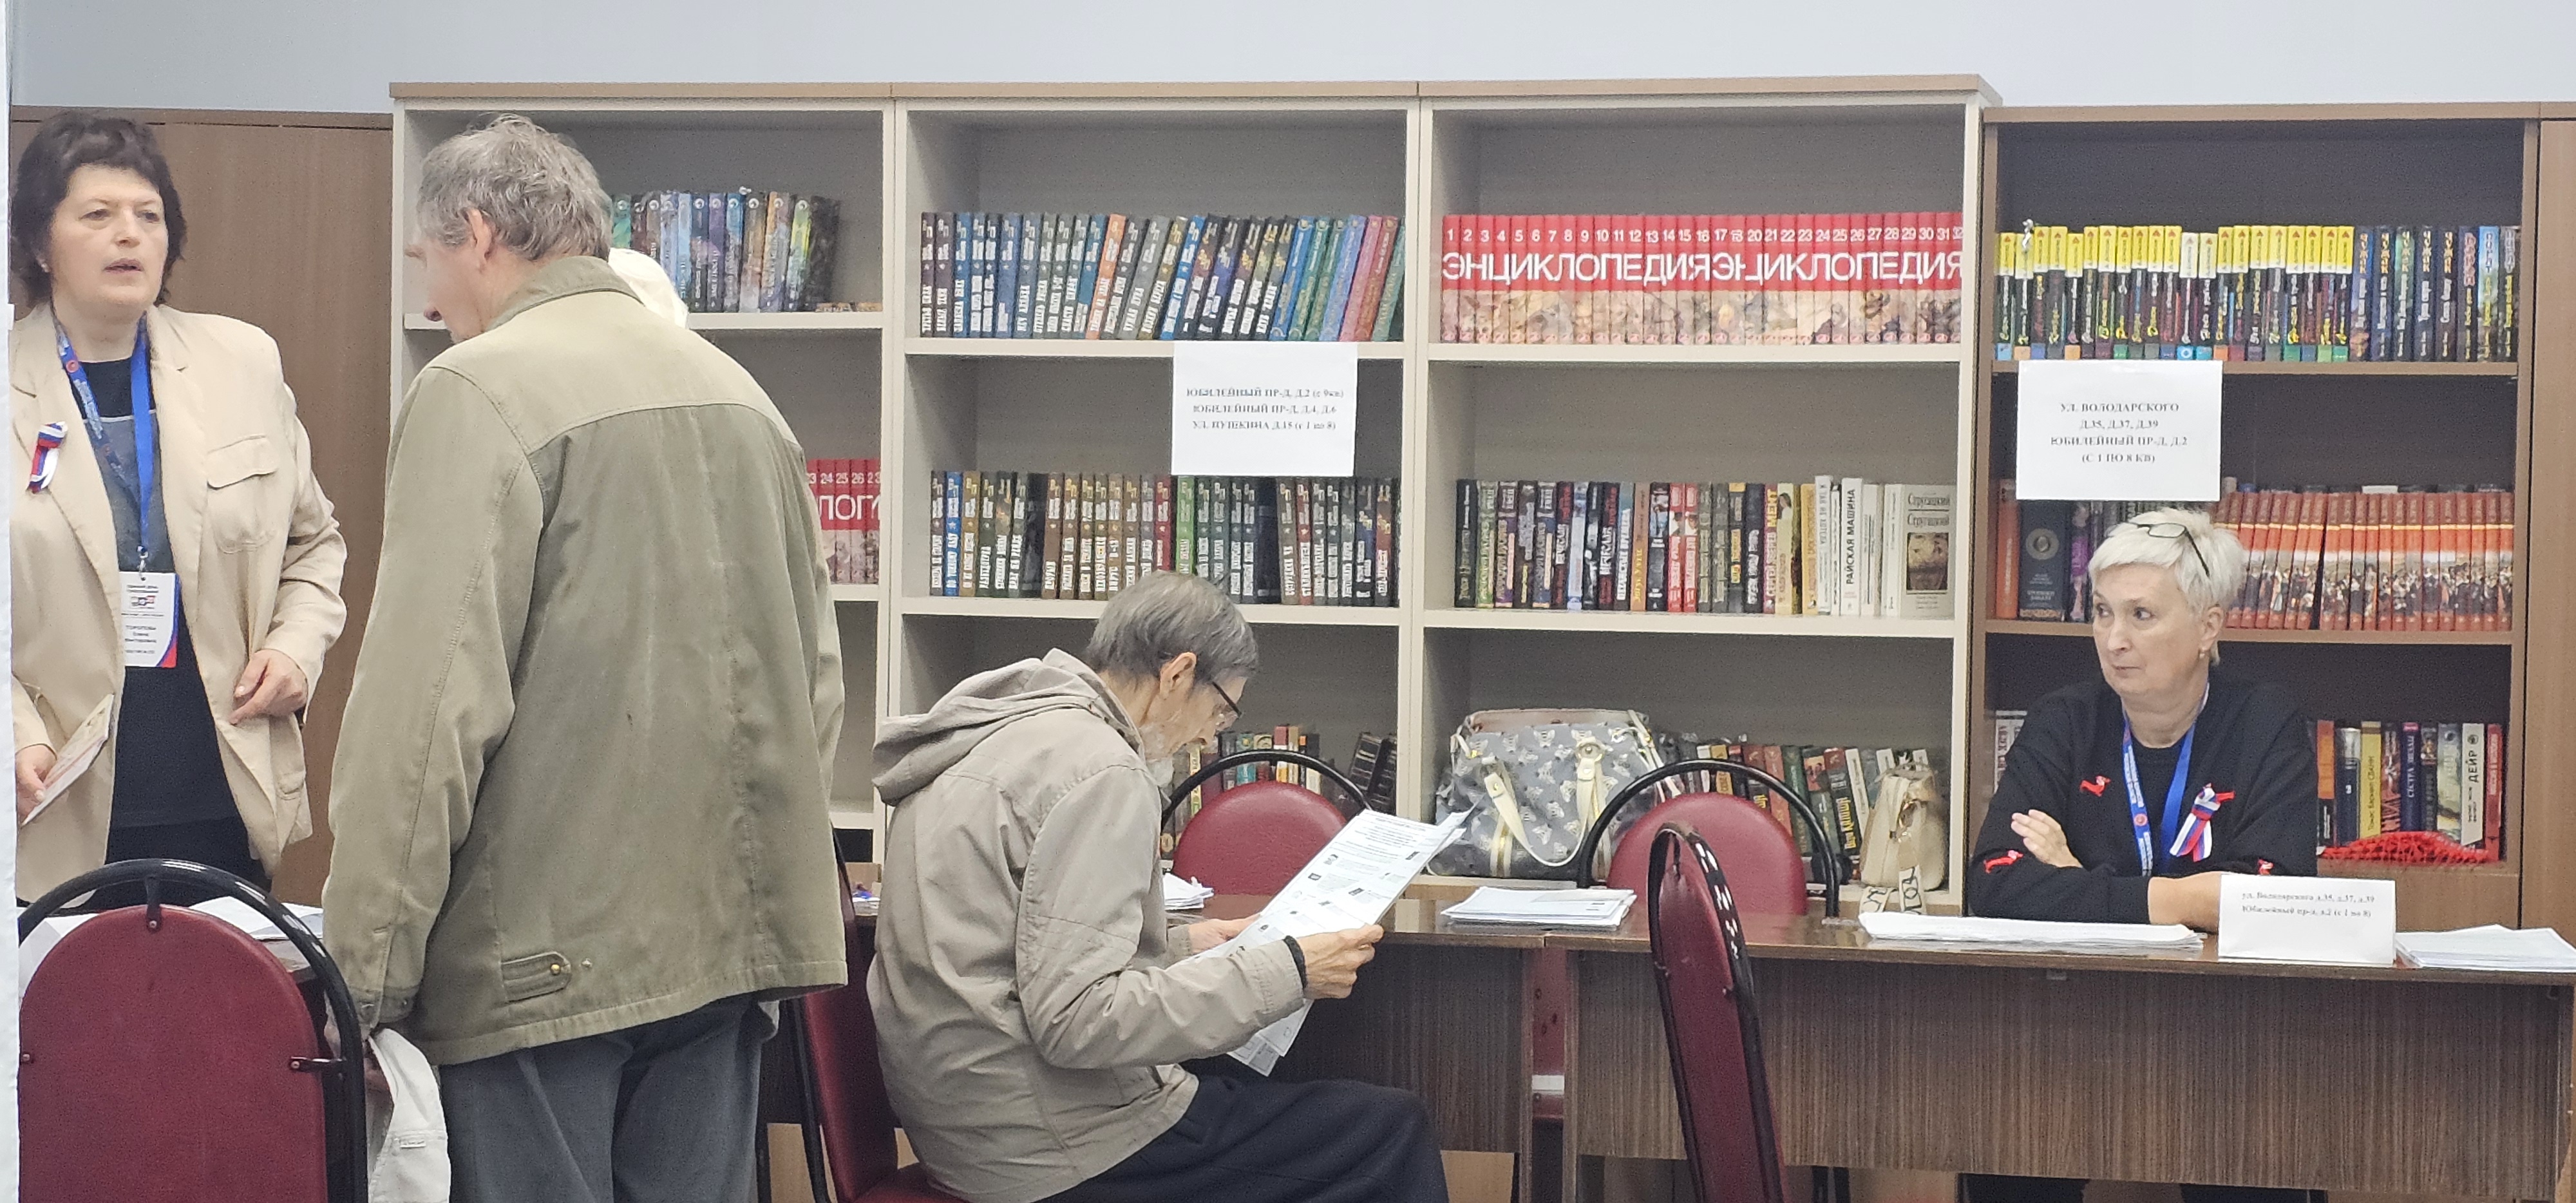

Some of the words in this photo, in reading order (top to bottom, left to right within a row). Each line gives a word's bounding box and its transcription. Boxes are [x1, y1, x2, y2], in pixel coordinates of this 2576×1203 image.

[1447, 229, 1454, 243] 1
[1463, 229, 1473, 243] 2
[1480, 229, 1490, 243] 3
[1496, 229, 1506, 243] 4
[1514, 229, 1524, 243] 5
[1531, 229, 1540, 243] 6
[1548, 229, 1557, 243] 7
[1564, 229, 1574, 243] 8
[1580, 229, 1589, 243] 9
[1596, 229, 1610, 243] 10
[1613, 229, 1624, 243] 11
[1629, 229, 1642, 243] 12
[1645, 229, 1659, 243] 13
[1663, 229, 1675, 243] 14
[1678, 229, 1692, 243] 15
[1696, 227, 1710, 242] 16
[1714, 227, 1728, 242] 17
[1747, 227, 1763, 242] 20
[1765, 227, 1777, 242] 21
[1781, 227, 1795, 242] 22
[1797, 227, 1812, 242] 23
[1815, 227, 1830, 242] 24
[1832, 227, 1848, 242] 25
[1850, 227, 1865, 242] 26
[1868, 227, 1882, 242] 27
[1884, 227, 1899, 242] 28
[1901, 227, 1917, 242] 29
[1918, 227, 1934, 242] 30
[1936, 227, 1950, 242] 31
[1442, 252, 1710, 287] ЭНЦИКЛОПЕДИЯ
[2081, 403, 2179, 413] ВОЛОДАРСКОГО
[2051, 435, 2134, 446] ЮБИЛЕЙНЫЙ
[820, 471, 833, 484] 24
[836, 472, 849, 484] 25
[851, 472, 864, 484] 26
[1766, 489, 1777, 528] МЕНТ
[1846, 489, 1855, 535] МАШИНА
[1844, 539, 1855, 585] РАЙСКАЯ
[2465, 750, 2479, 782] ДЕЙР
